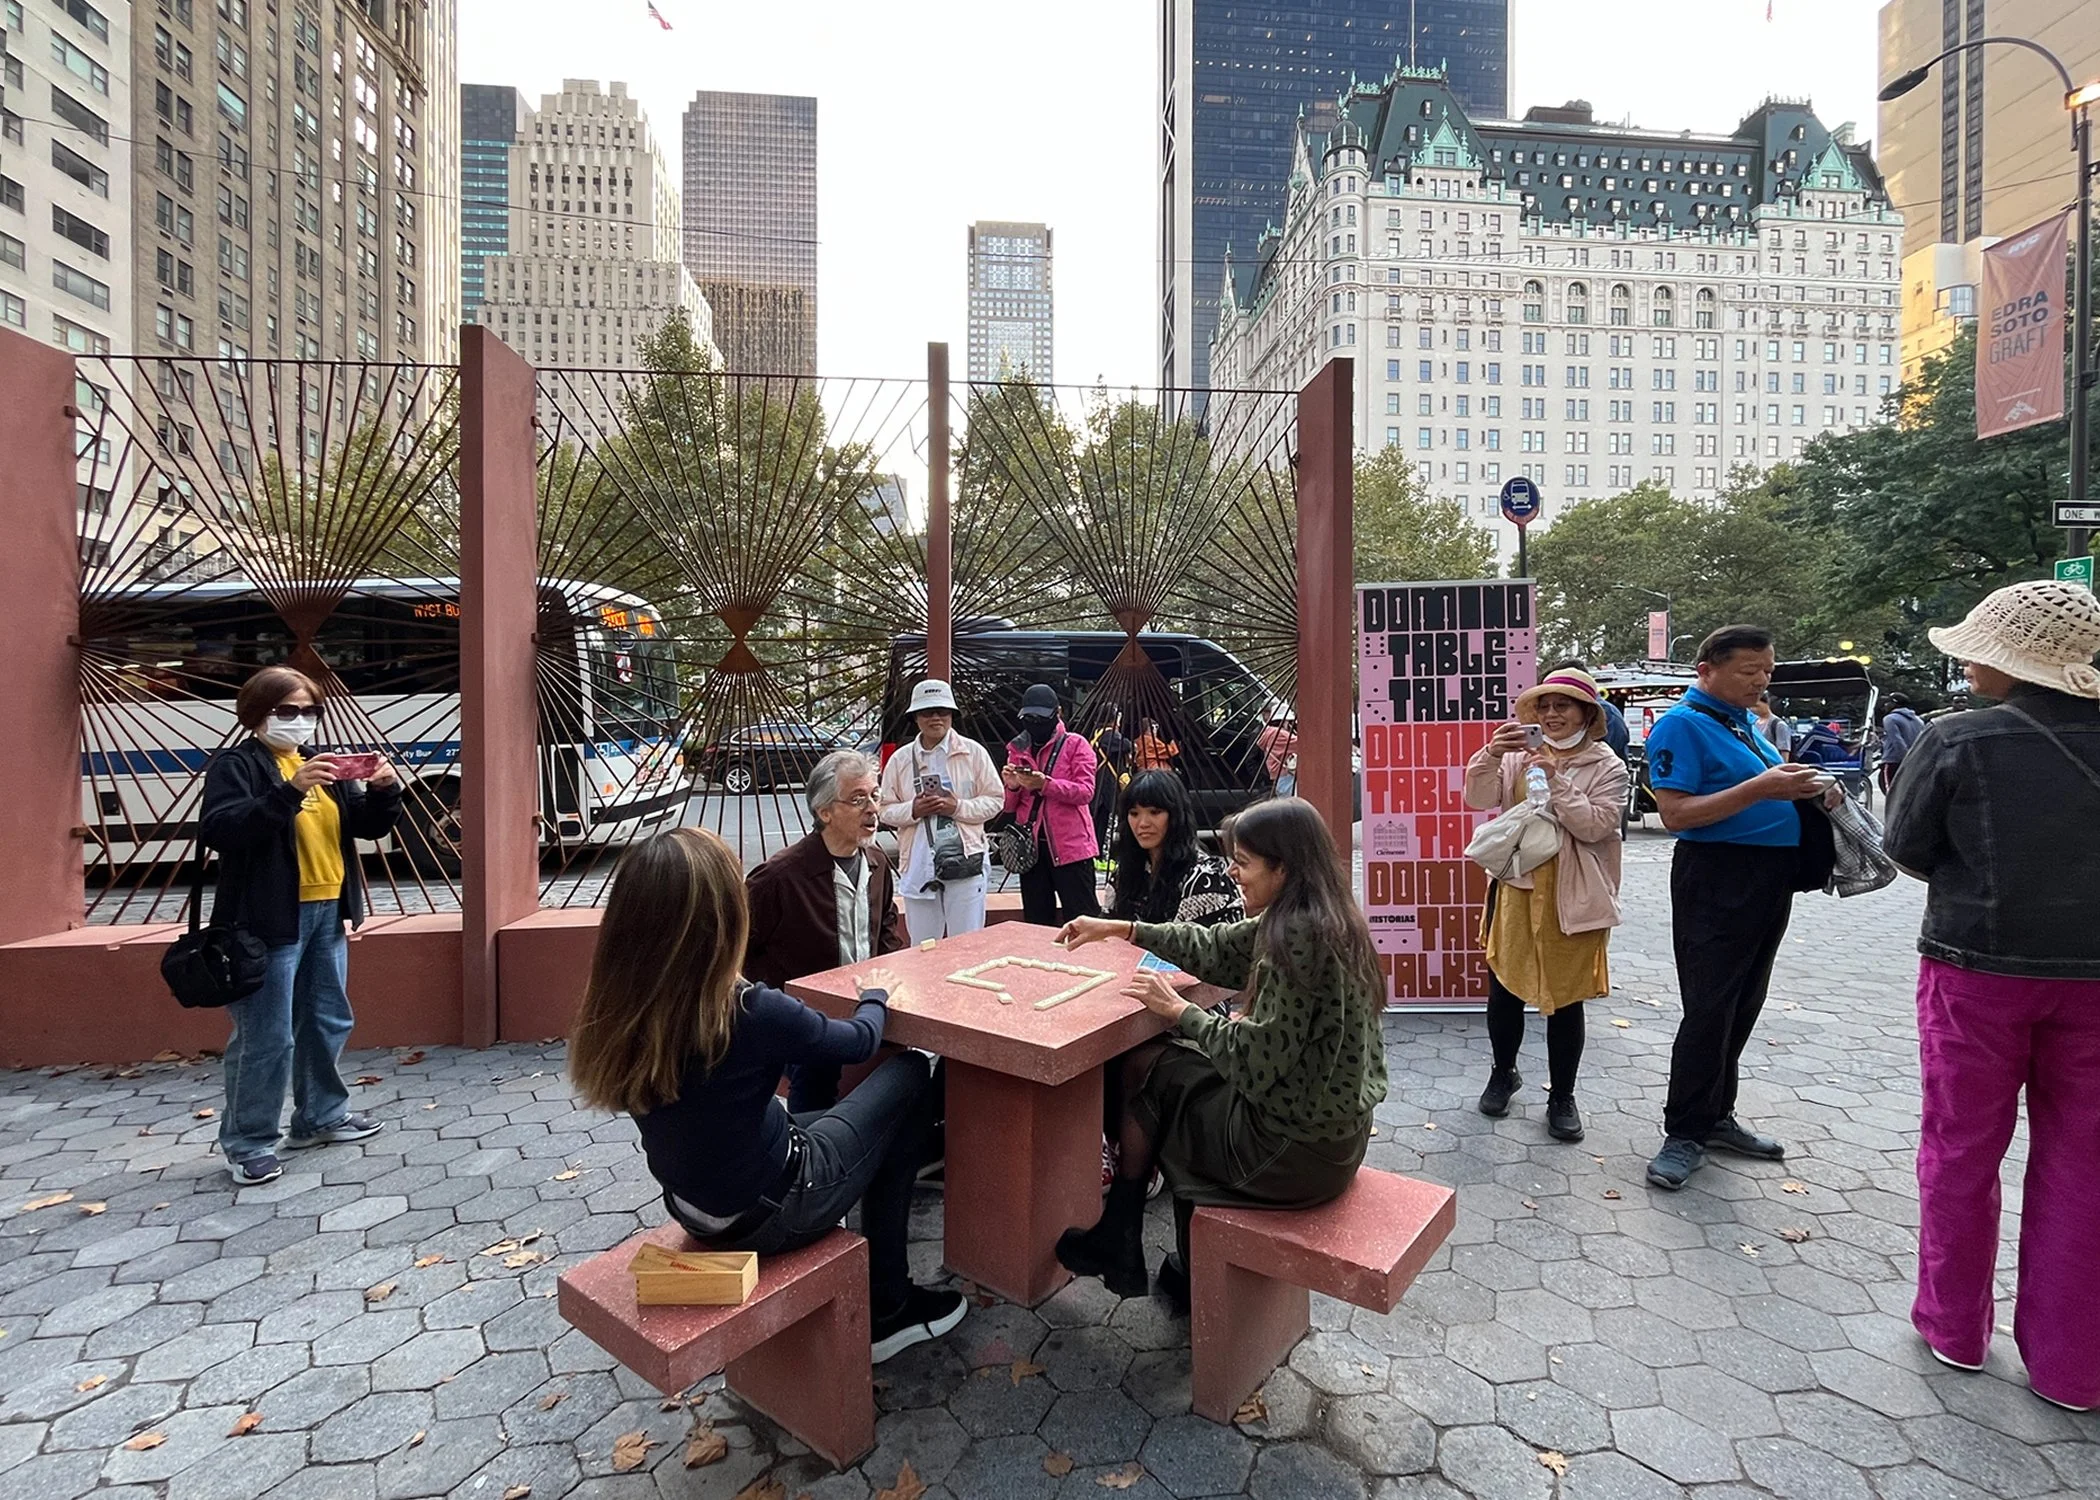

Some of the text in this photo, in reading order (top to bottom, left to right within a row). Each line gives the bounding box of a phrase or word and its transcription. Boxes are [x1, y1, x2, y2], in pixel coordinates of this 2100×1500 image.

[1991, 290, 2049, 322] EDRA
[1990, 307, 2049, 339] SOTO
[1989, 323, 2049, 365] GRAFT
[2064, 509, 2085, 519] ONE
[445, 603, 461, 617] BU
[1363, 585, 1530, 633] DOMINO
[1388, 631, 1506, 677] TABLE
[1388, 676, 1507, 723] TALKS
[1657, 749, 1673, 778] 3
[1369, 914, 1416, 923] HISTORIAS
